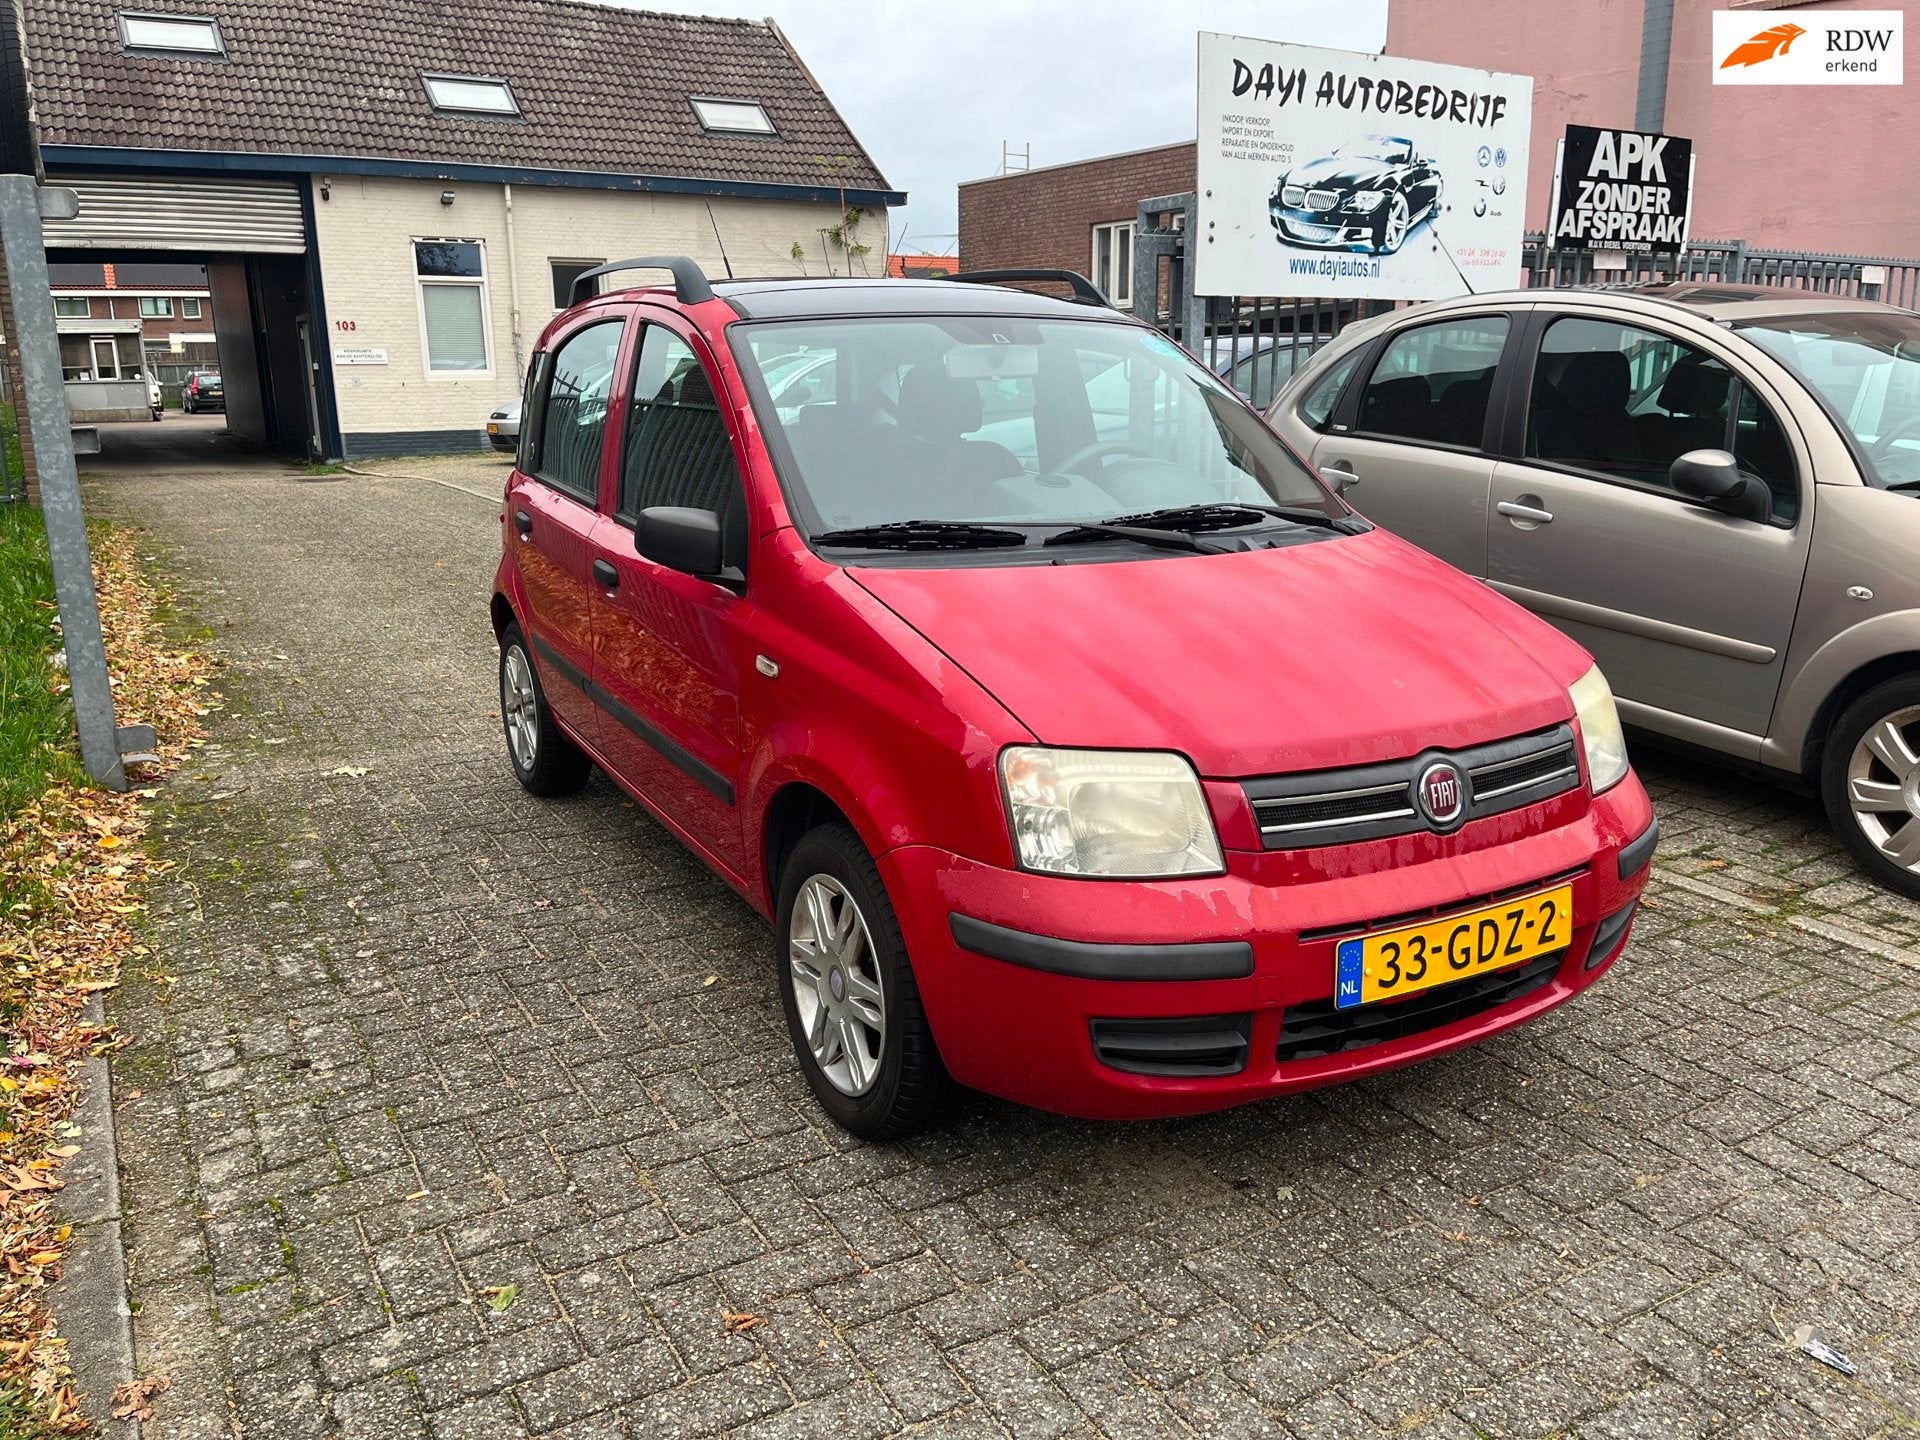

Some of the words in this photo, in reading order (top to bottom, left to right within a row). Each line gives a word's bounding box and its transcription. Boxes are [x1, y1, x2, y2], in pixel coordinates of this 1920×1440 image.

[1232, 58, 1307, 107] DAYI
[1315, 71, 1507, 129] AUTOBEDRIJF
[1587, 130, 1670, 183] APK
[1575, 180, 1671, 215] ZONDER
[1557, 208, 1684, 243] AFSPRAAK
[1289, 256, 1380, 281] www.dayiautos.nl
[336, 320, 356, 331] 103
[1429, 778, 1456, 809] FIAT
[1377, 899, 1558, 989] 33-GDZ-2
[1340, 979, 1359, 996] NL
